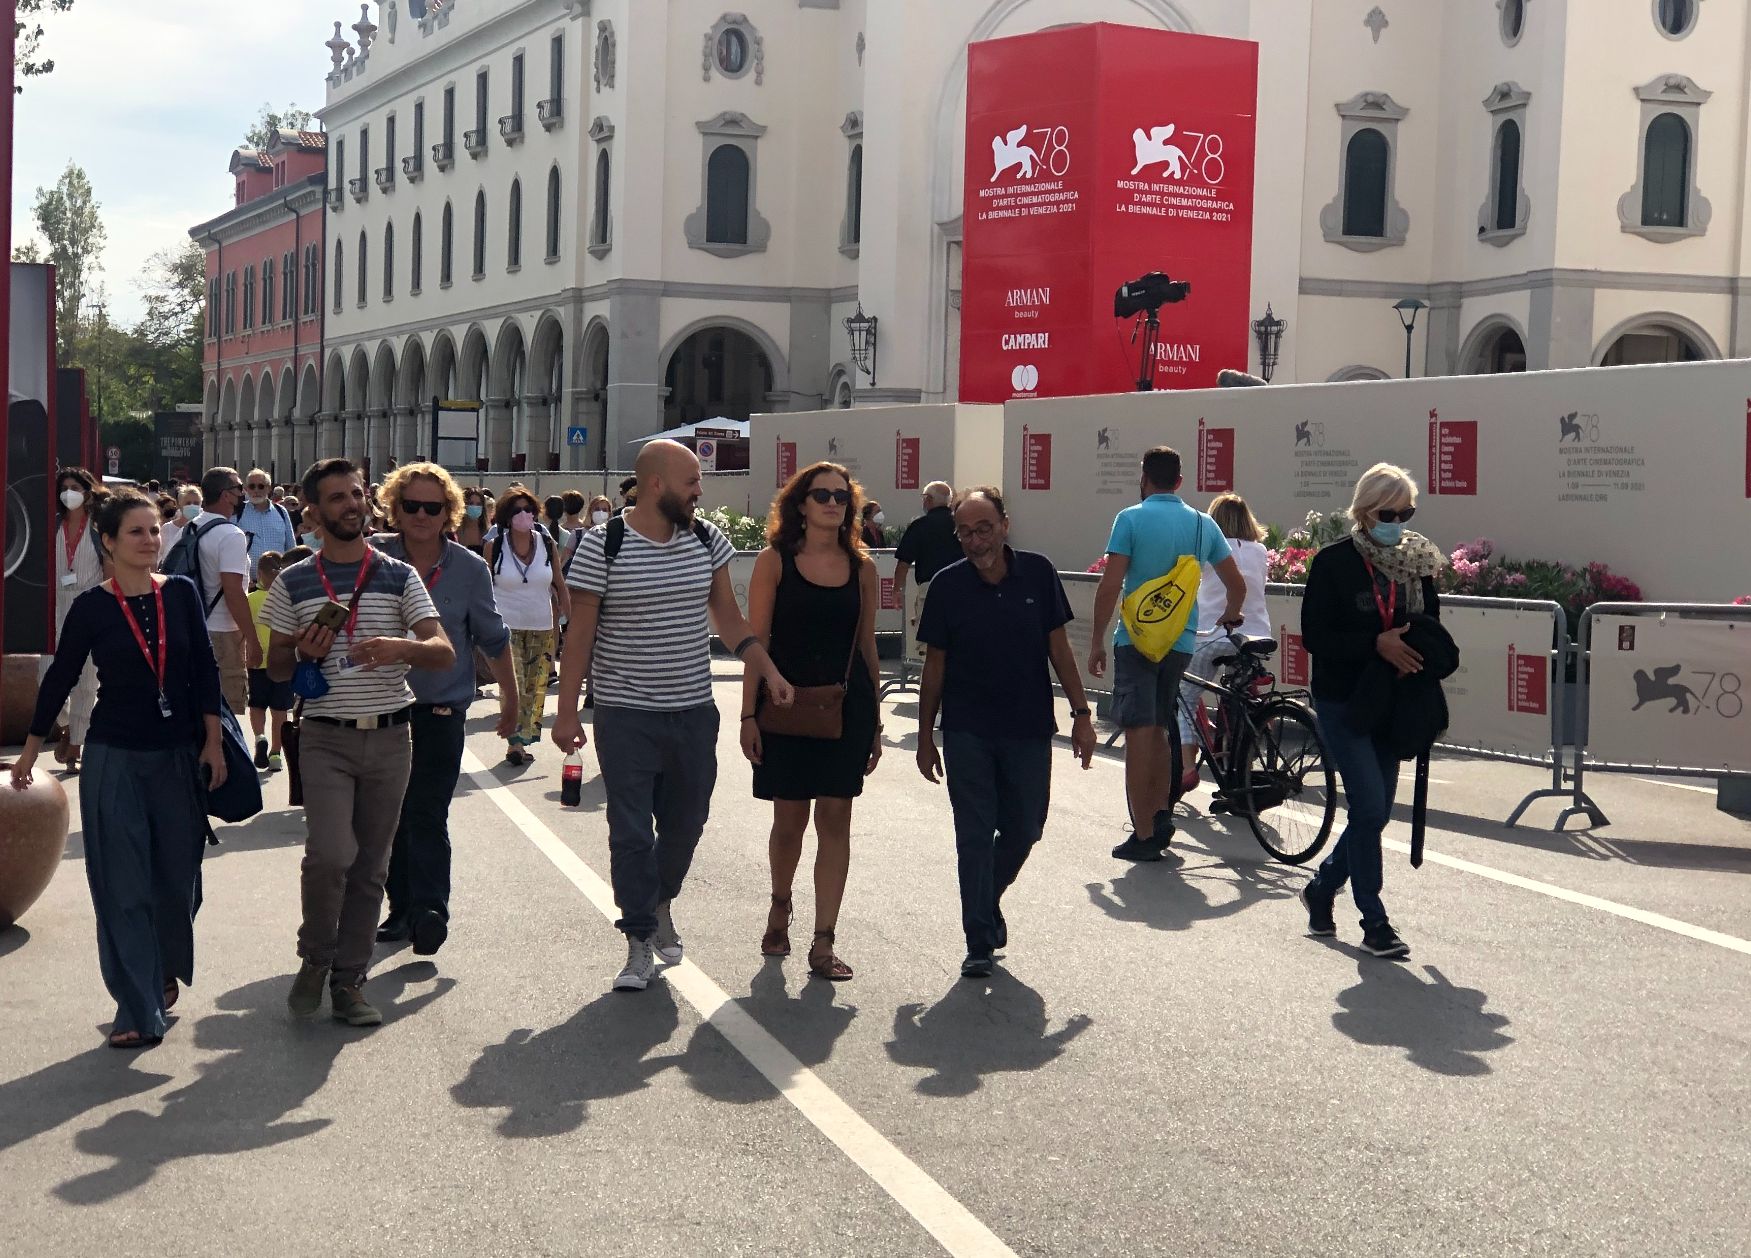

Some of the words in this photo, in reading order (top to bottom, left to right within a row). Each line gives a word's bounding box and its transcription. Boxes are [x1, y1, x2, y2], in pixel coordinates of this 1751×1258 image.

[1033, 126, 1070, 178] 78
[1182, 131, 1225, 184] 78
[979, 187, 1006, 197] MOSTRA
[1006, 181, 1063, 194] INTERNAZIONALE
[1116, 180, 1149, 190] MOSTRA
[1151, 183, 1216, 197] INTERNAZIONALE
[993, 198, 1015, 207] D'ARTE
[1016, 191, 1079, 205] CINEMATOGRAFICA
[1133, 193, 1161, 204] D'ARTE
[1163, 196, 1234, 210] CINEMATOGRAFICA
[978, 212, 987, 220] LA
[988, 208, 1020, 219] BIENNALE
[1021, 208, 1028, 216] DI
[1029, 205, 1058, 215] VENEZIA
[1060, 203, 1076, 212] 2021
[1116, 204, 1126, 212] LA
[1128, 205, 1167, 216] BIENNALE
[1168, 208, 1176, 217] DI
[1178, 209, 1211, 220] VENEZIA
[1212, 212, 1231, 222] 2021
[1005, 287, 1050, 307] ARMANI
[1014, 310, 1039, 319] beauty
[1001, 332, 1049, 350] CAMPARI
[1149, 342, 1200, 362] ARMANI
[1158, 363, 1187, 375] beauty
[1581, 413, 1600, 442] 78
[1559, 446, 1583, 455] MOSTRA
[1584, 446, 1635, 454] INTERNAZIONALE
[1589, 458, 1645, 466] CINEMATOGRAFICA
[1558, 470, 1566, 478] LA
[1567, 470, 1595, 478] BIENNALE
[1597, 470, 1604, 478] DI
[1605, 470, 1631, 478] VENEZIA
[1558, 493, 1608, 502] LABIENNALE.ORG
[1691, 671, 1743, 718] 78
